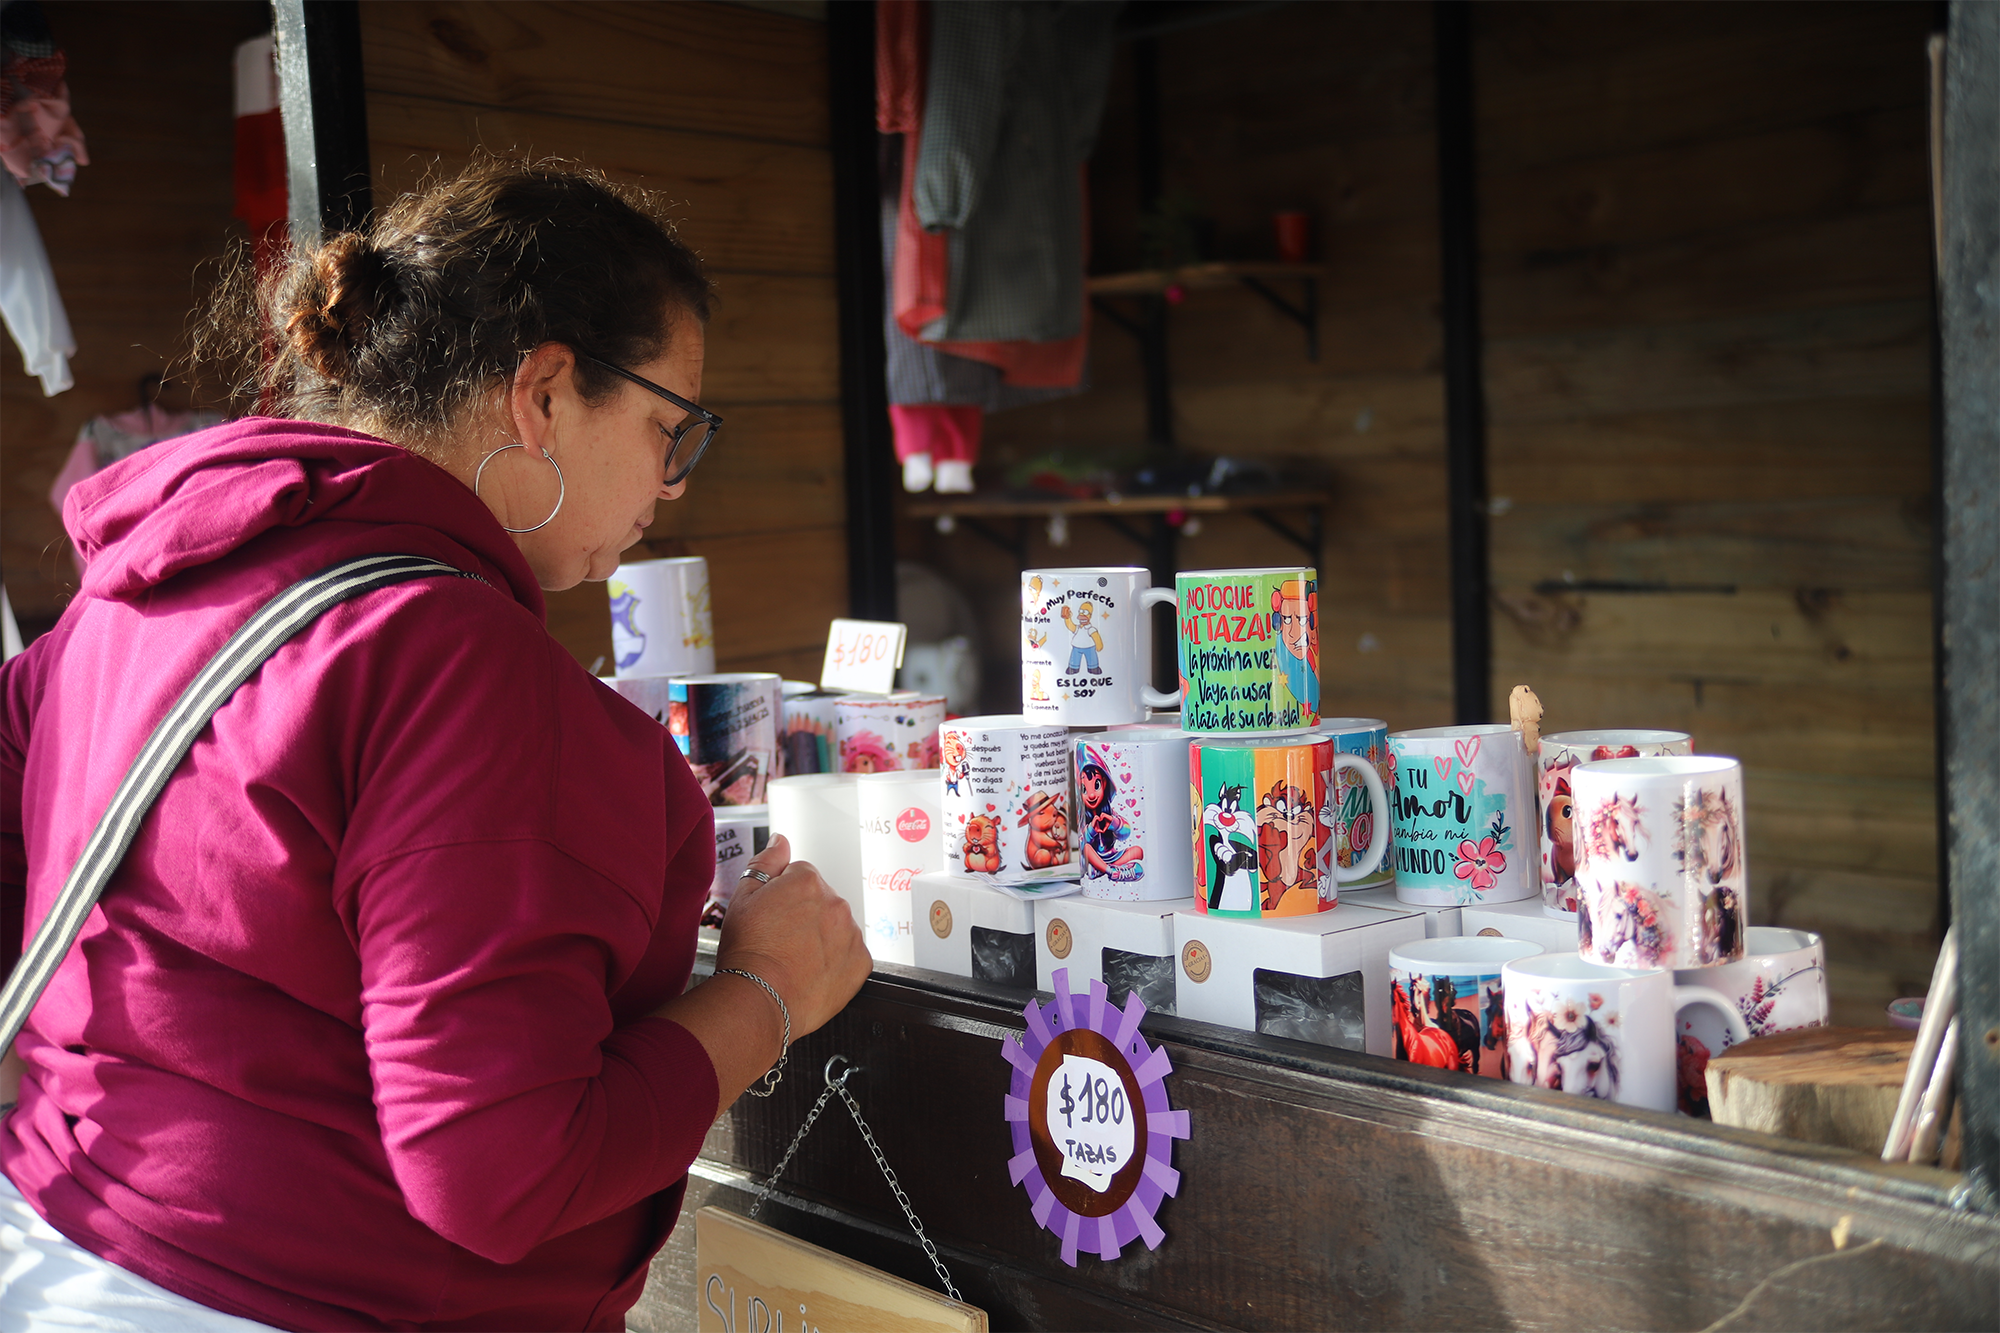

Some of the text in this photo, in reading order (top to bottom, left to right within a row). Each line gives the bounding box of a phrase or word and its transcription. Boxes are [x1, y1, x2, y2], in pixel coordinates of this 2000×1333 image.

[1046, 589, 1115, 610] Muy Perfecto
[1204, 584, 1255, 611] TOQUE
[1181, 612, 1272, 645] MI TAZA!
[833, 628, 889, 672] $180
[1199, 645, 1253, 680] próxima
[1253, 648, 1278, 670] vez
[1072, 678, 1088, 688] LO
[1090, 676, 1113, 687] QUE
[1230, 685, 1241, 701] a
[1242, 682, 1273, 701] usar
[1073, 689, 1096, 698] SOY
[1195, 701, 1220, 730] taza
[1221, 703, 1237, 731] de
[1238, 709, 1255, 728] su
[982, 734, 990, 742] Si
[1020, 733, 1029, 741] Yo
[971, 745, 1002, 754] después
[1020, 753, 1031, 761] pa
[1032, 752, 1045, 760] que
[982, 775, 1003, 785] digas
[1406, 768, 1428, 790] TU
[1391, 785, 1472, 824] Amor
[1393, 817, 1438, 842] cambia
[1444, 828, 1470, 840] mi
[1059, 1072, 1125, 1129] $180
[1065, 1139, 1117, 1165] TAZAS
